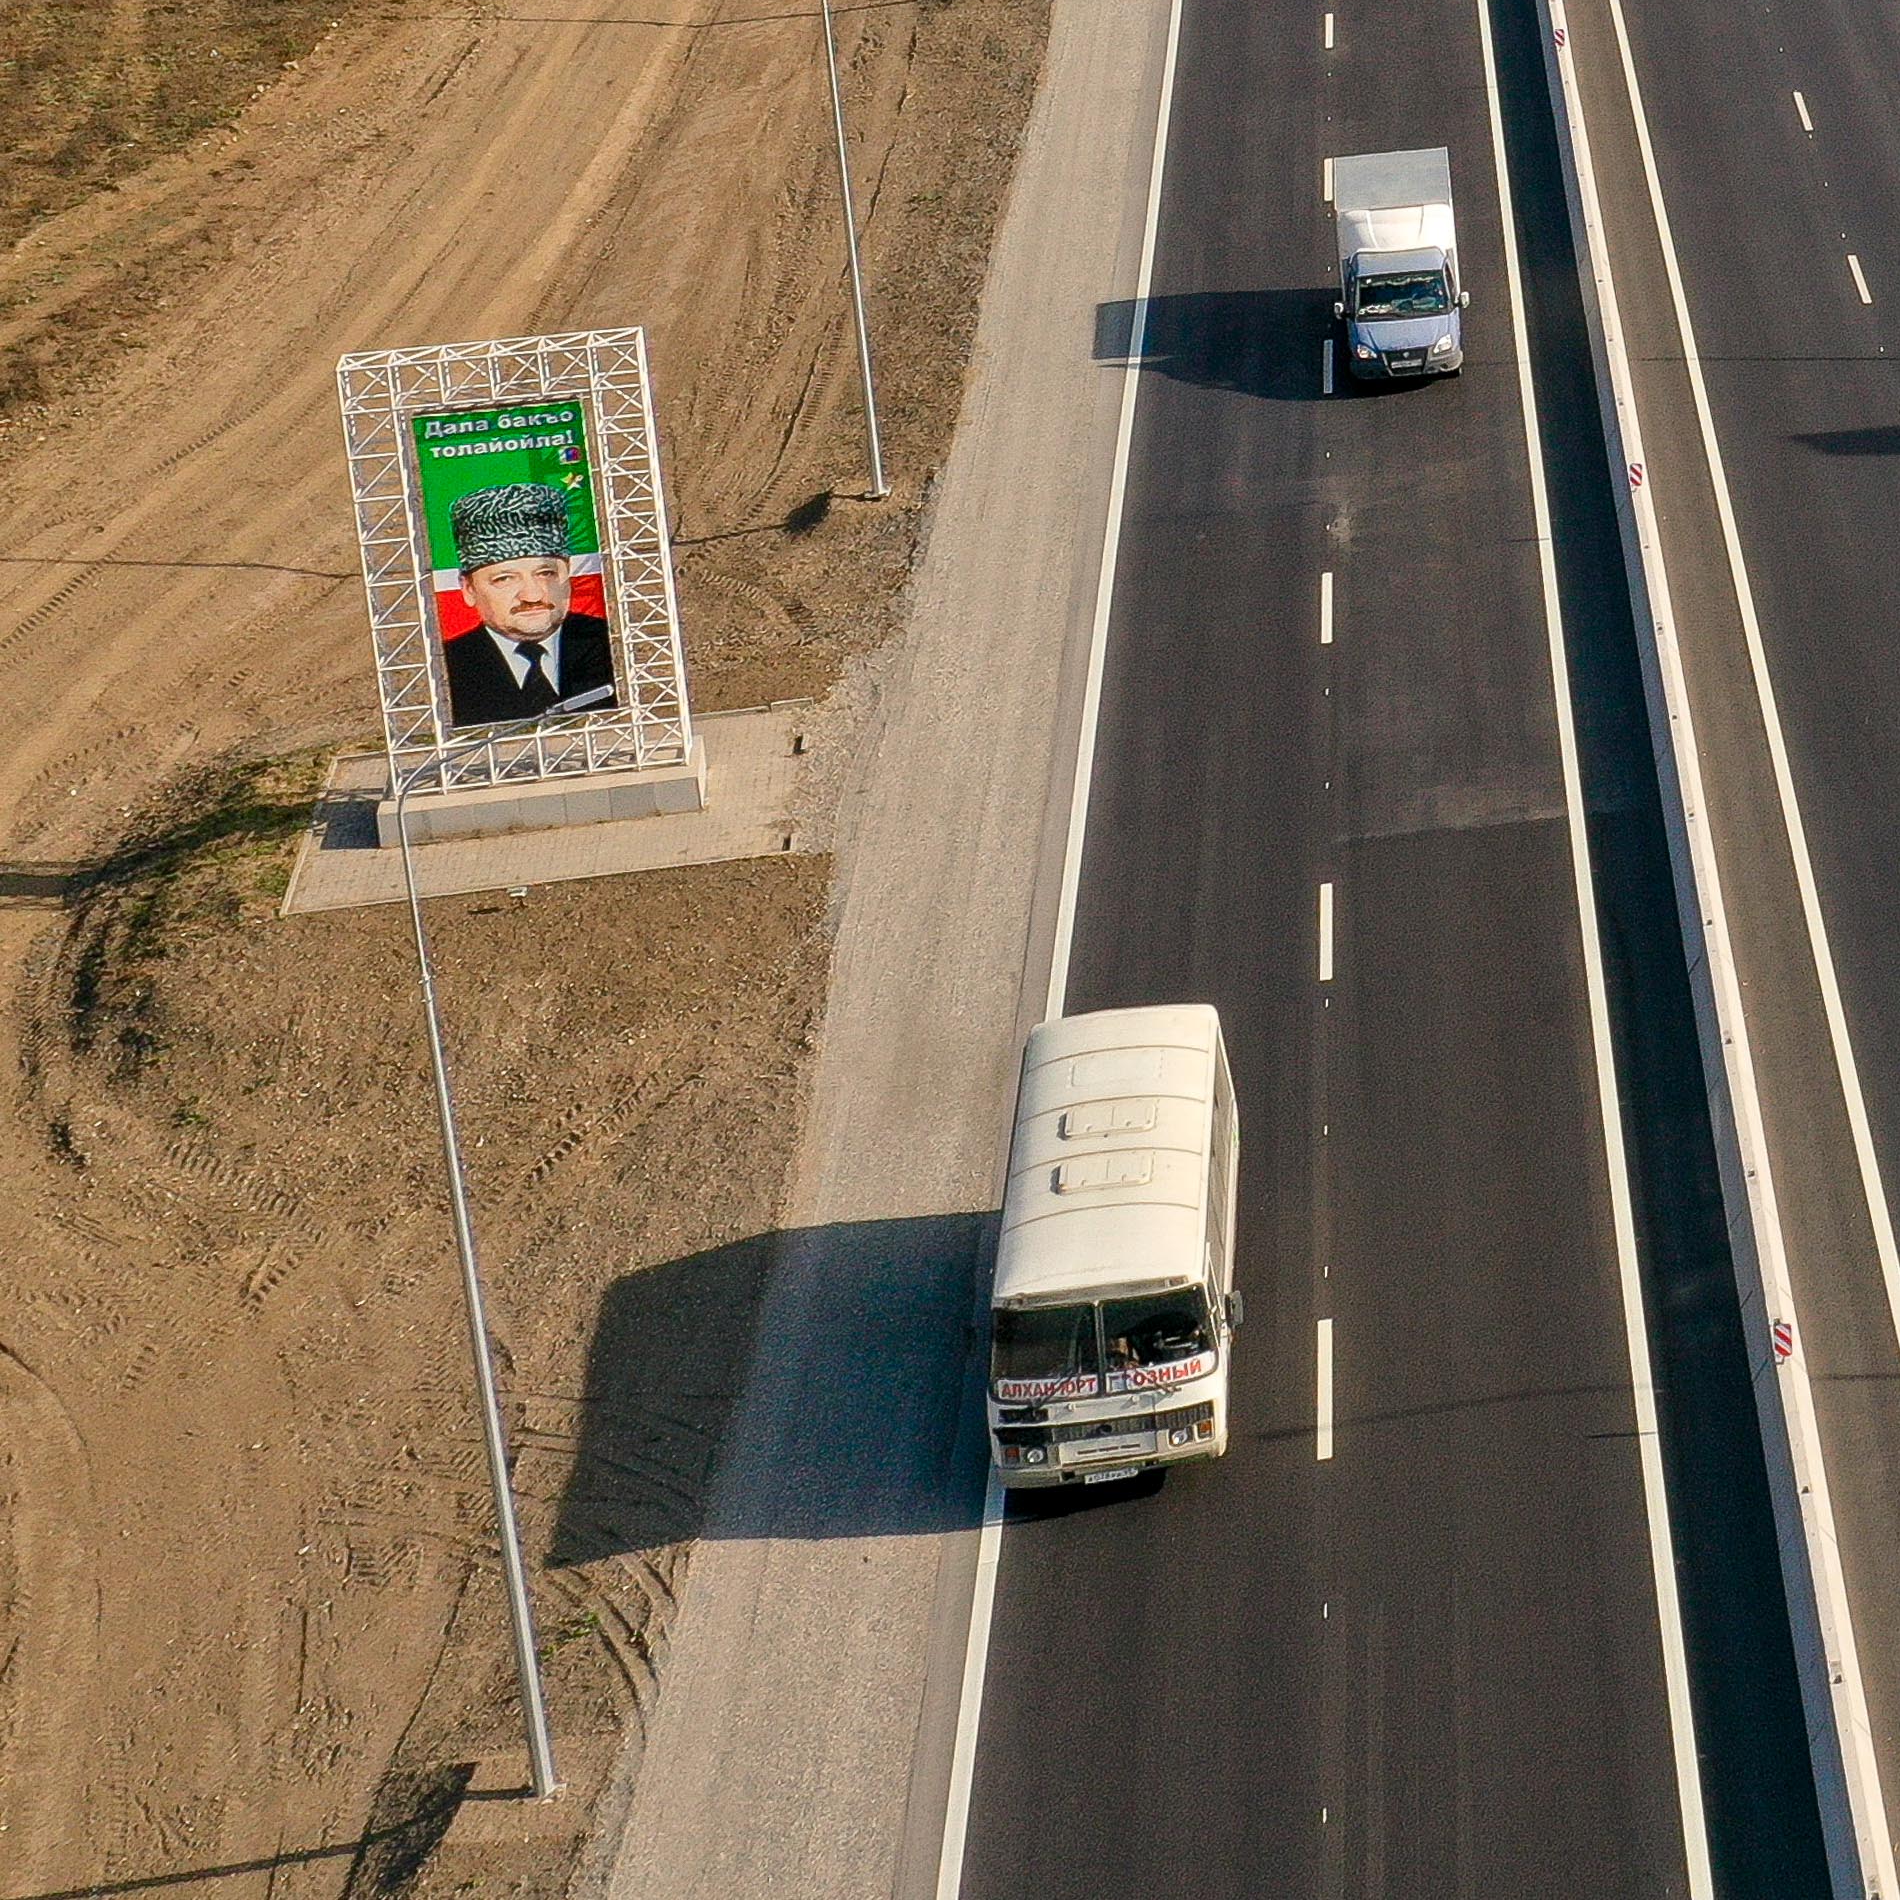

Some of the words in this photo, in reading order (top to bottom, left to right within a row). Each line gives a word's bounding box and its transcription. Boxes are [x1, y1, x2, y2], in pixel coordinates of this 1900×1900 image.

[425, 419, 489, 439] Дала
[497, 410, 574, 429] бакъо
[429, 429, 574, 458] толайойла!
